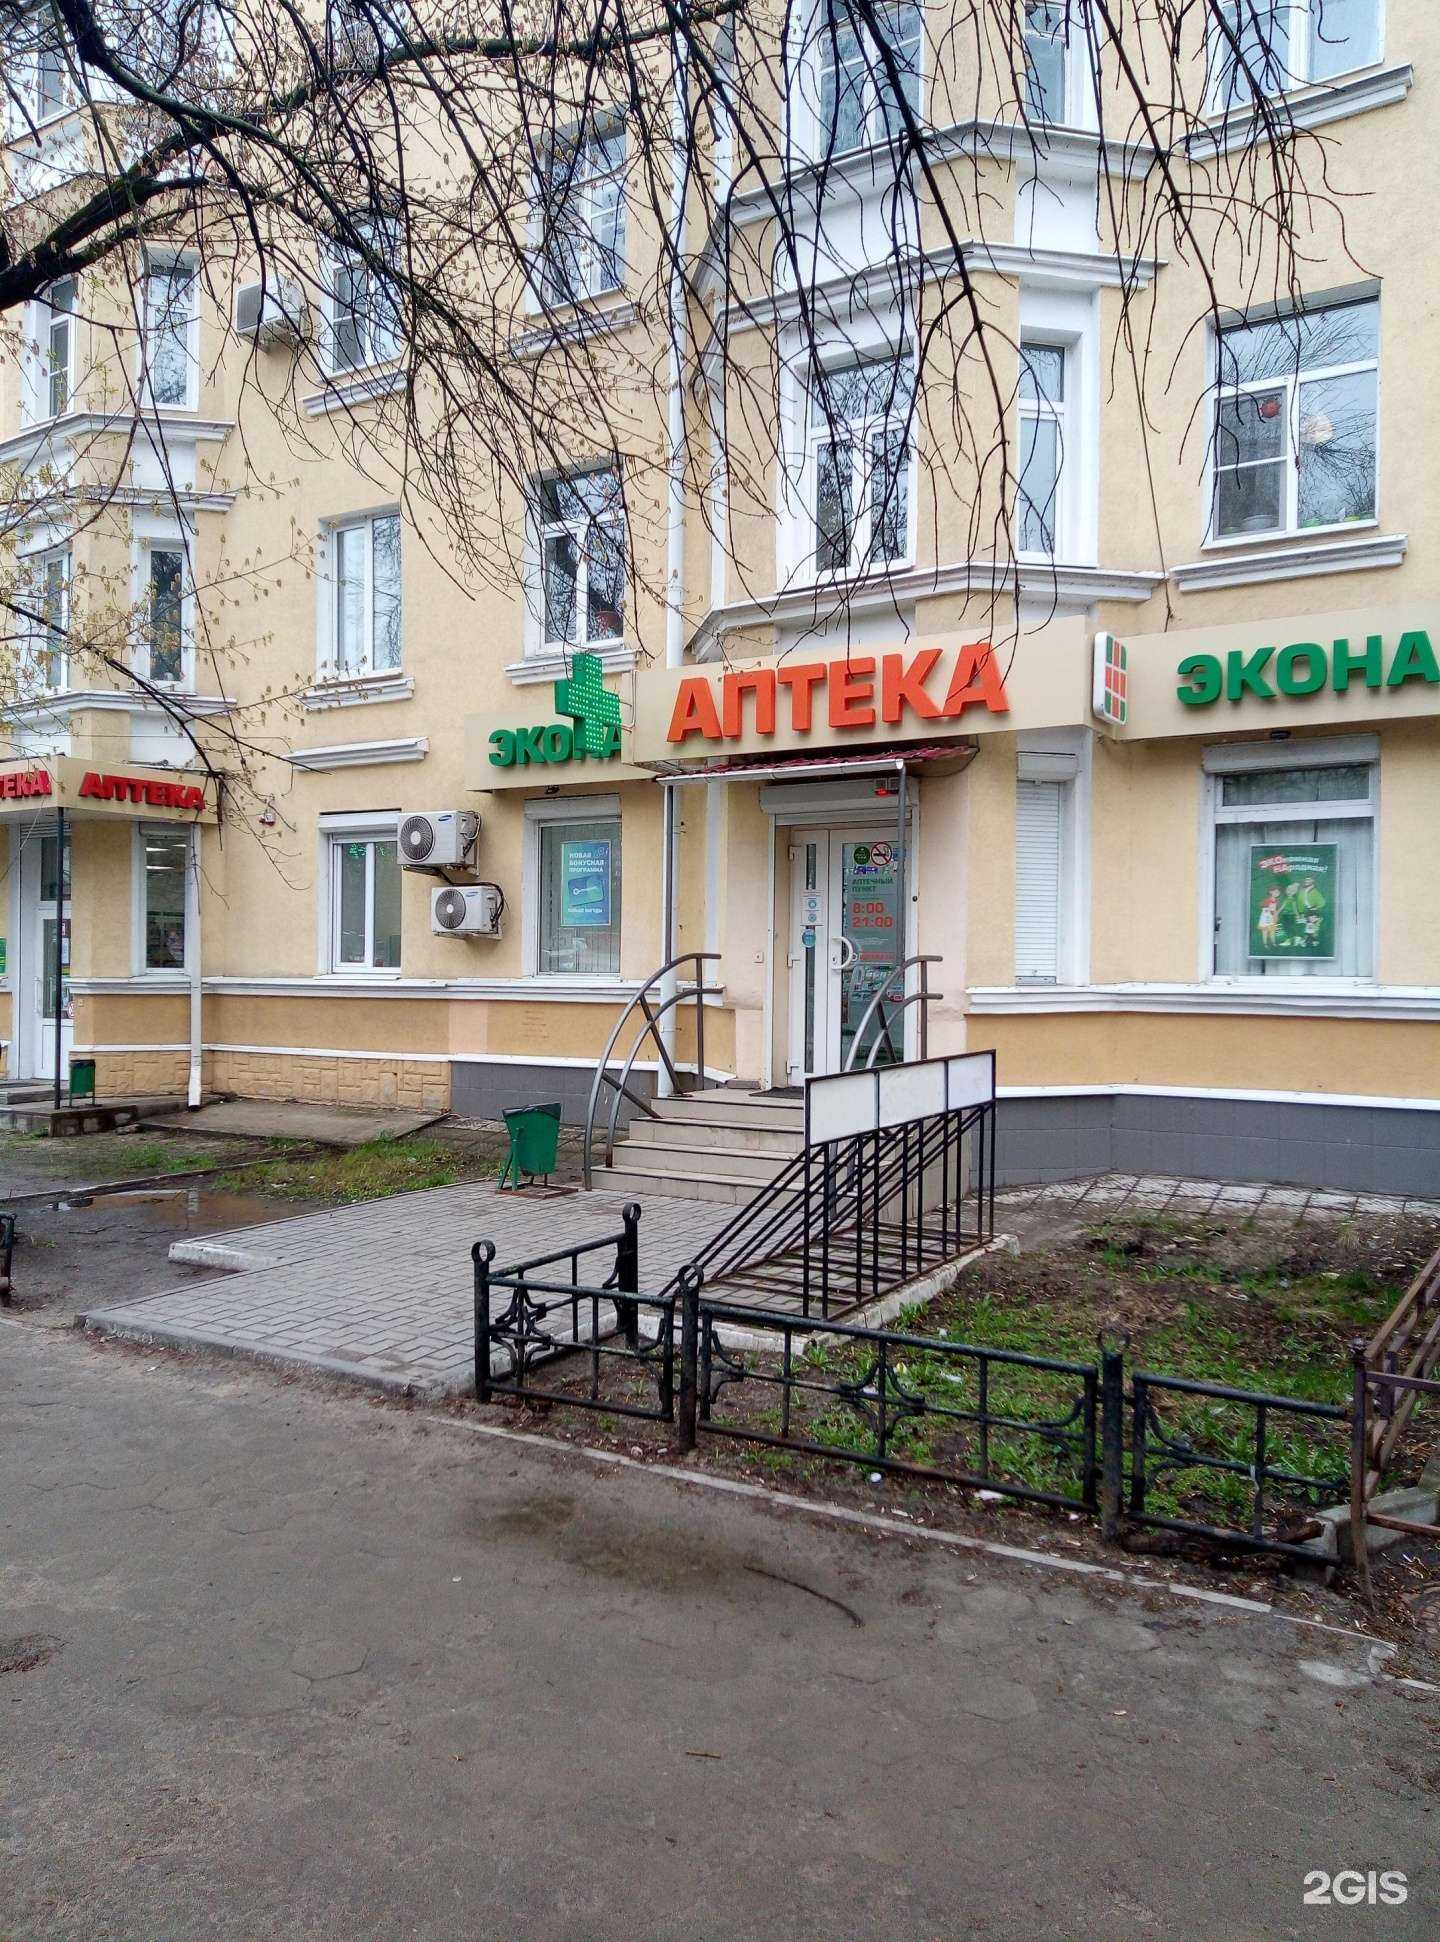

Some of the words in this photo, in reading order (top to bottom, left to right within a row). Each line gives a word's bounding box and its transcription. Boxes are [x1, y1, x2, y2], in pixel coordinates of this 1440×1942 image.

[1176, 630, 1440, 708] ЭКОНА
[667, 642, 1010, 743] АПТЕКА
[489, 723, 622, 767] ЭКОА
[0, 770, 52, 799] ЕКА
[79, 772, 206, 810] АПТЕКА
[852, 902, 884, 914] 8:00
[852, 916, 894, 928] 21:00
